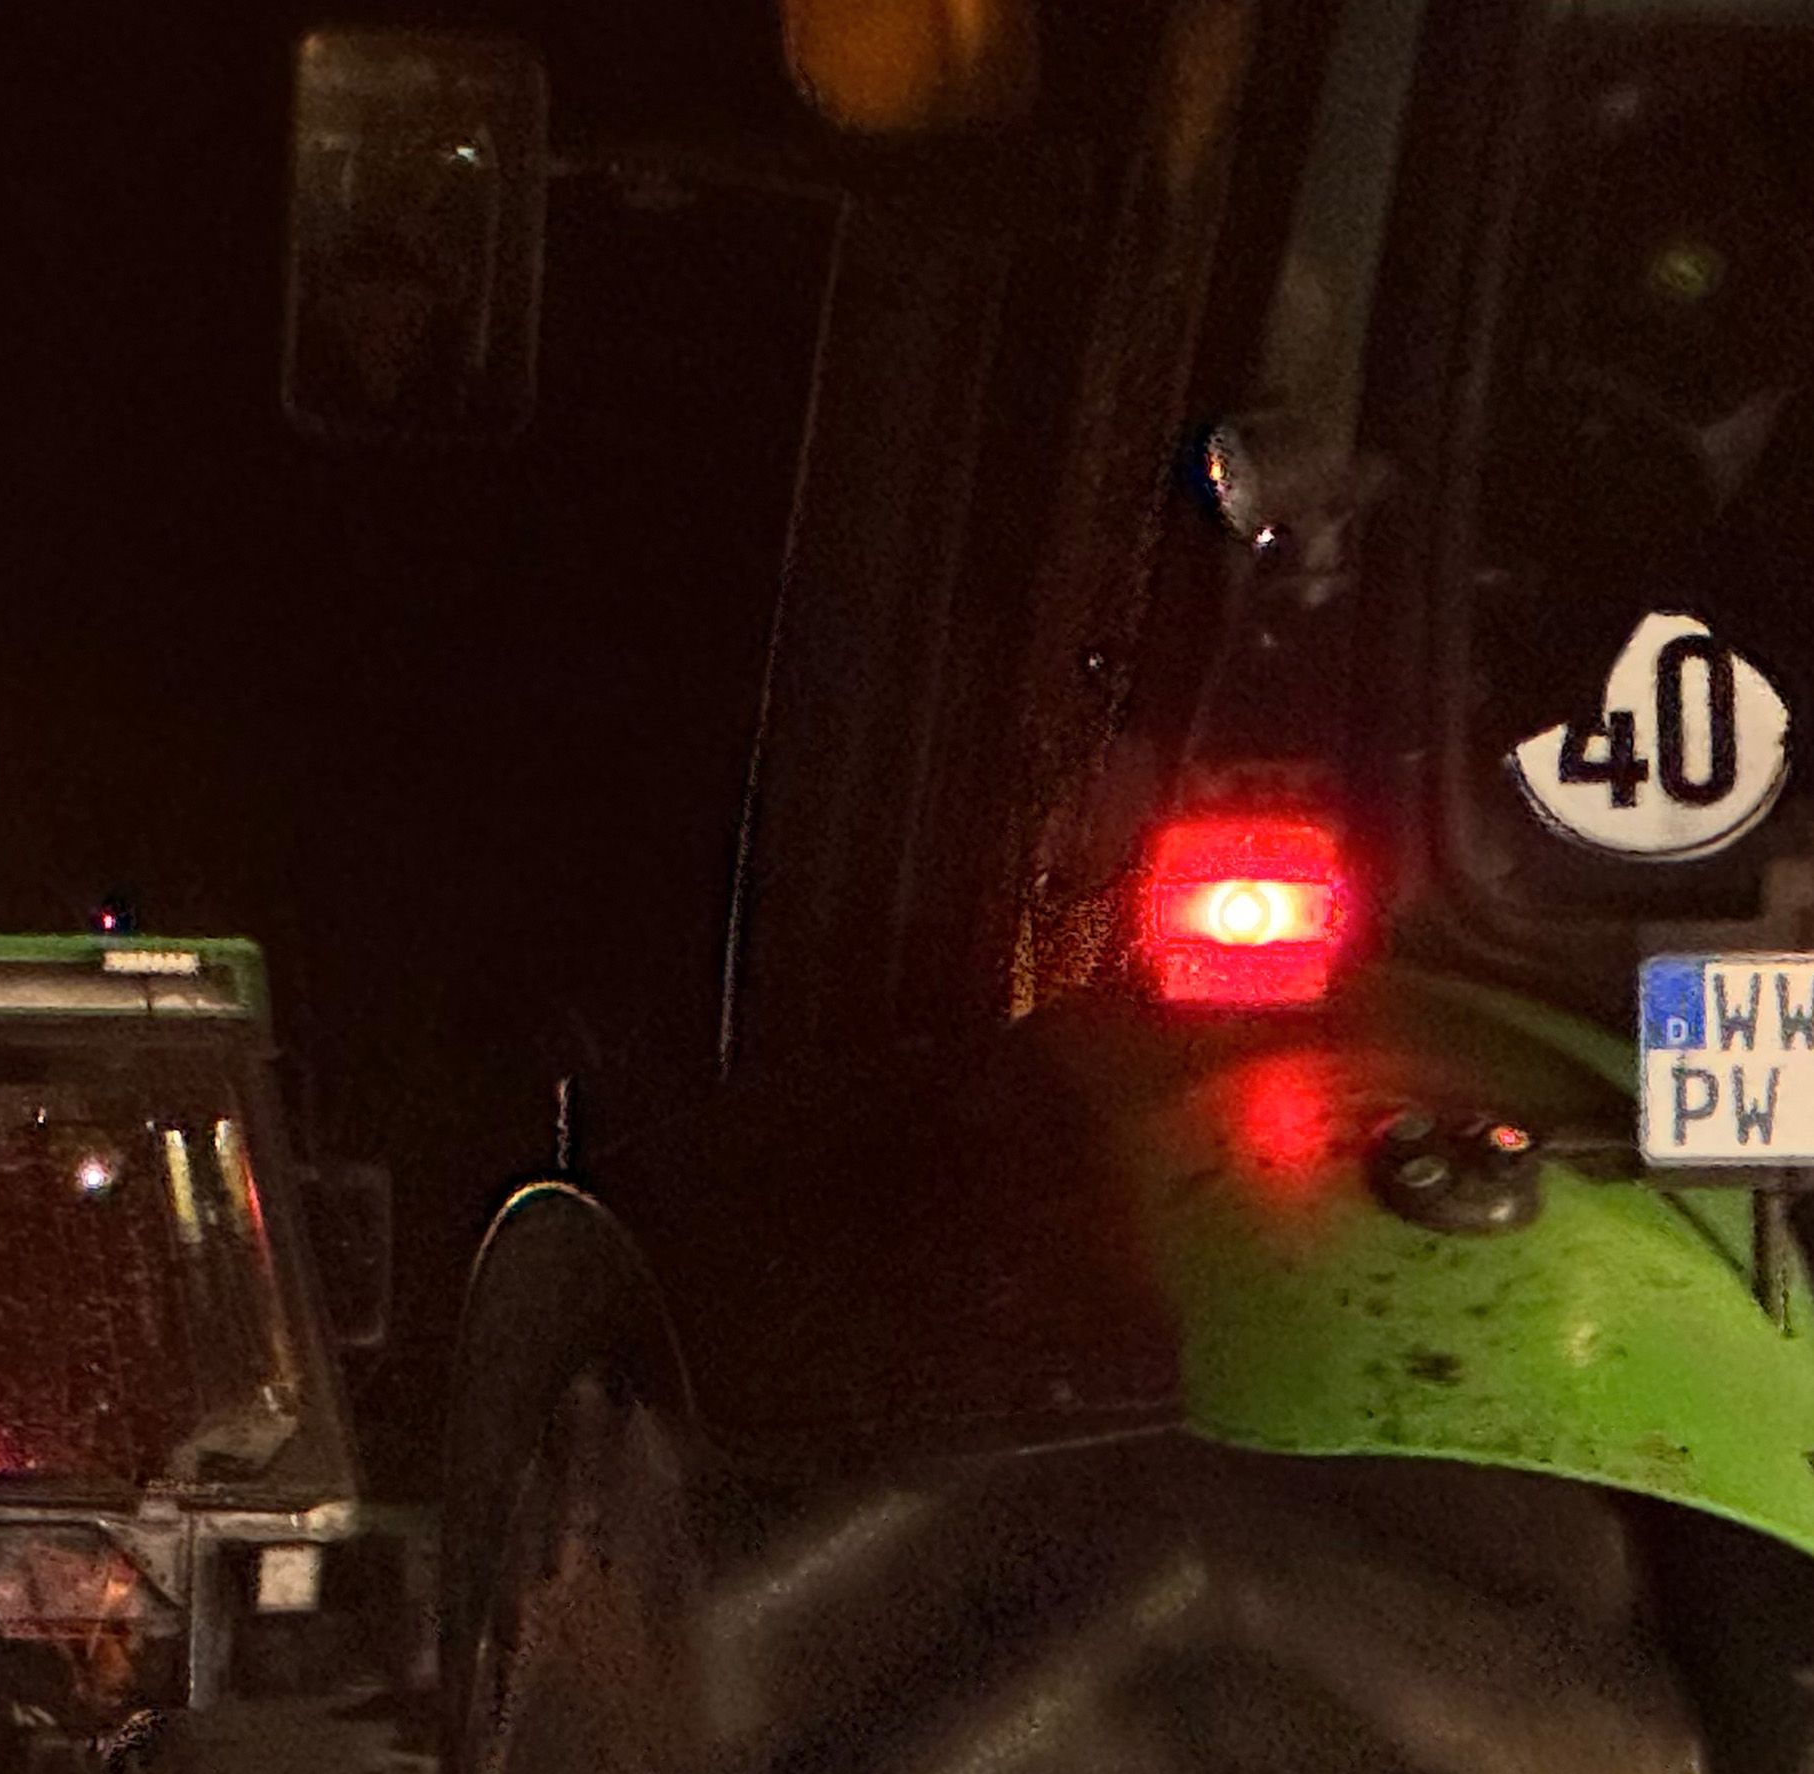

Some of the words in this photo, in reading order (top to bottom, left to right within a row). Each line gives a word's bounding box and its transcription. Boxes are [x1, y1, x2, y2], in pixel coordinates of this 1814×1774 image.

[1666, 1016, 1689, 1045] D
[1713, 972, 1814, 1051] WW
[1672, 1064, 1780, 1147] PW
